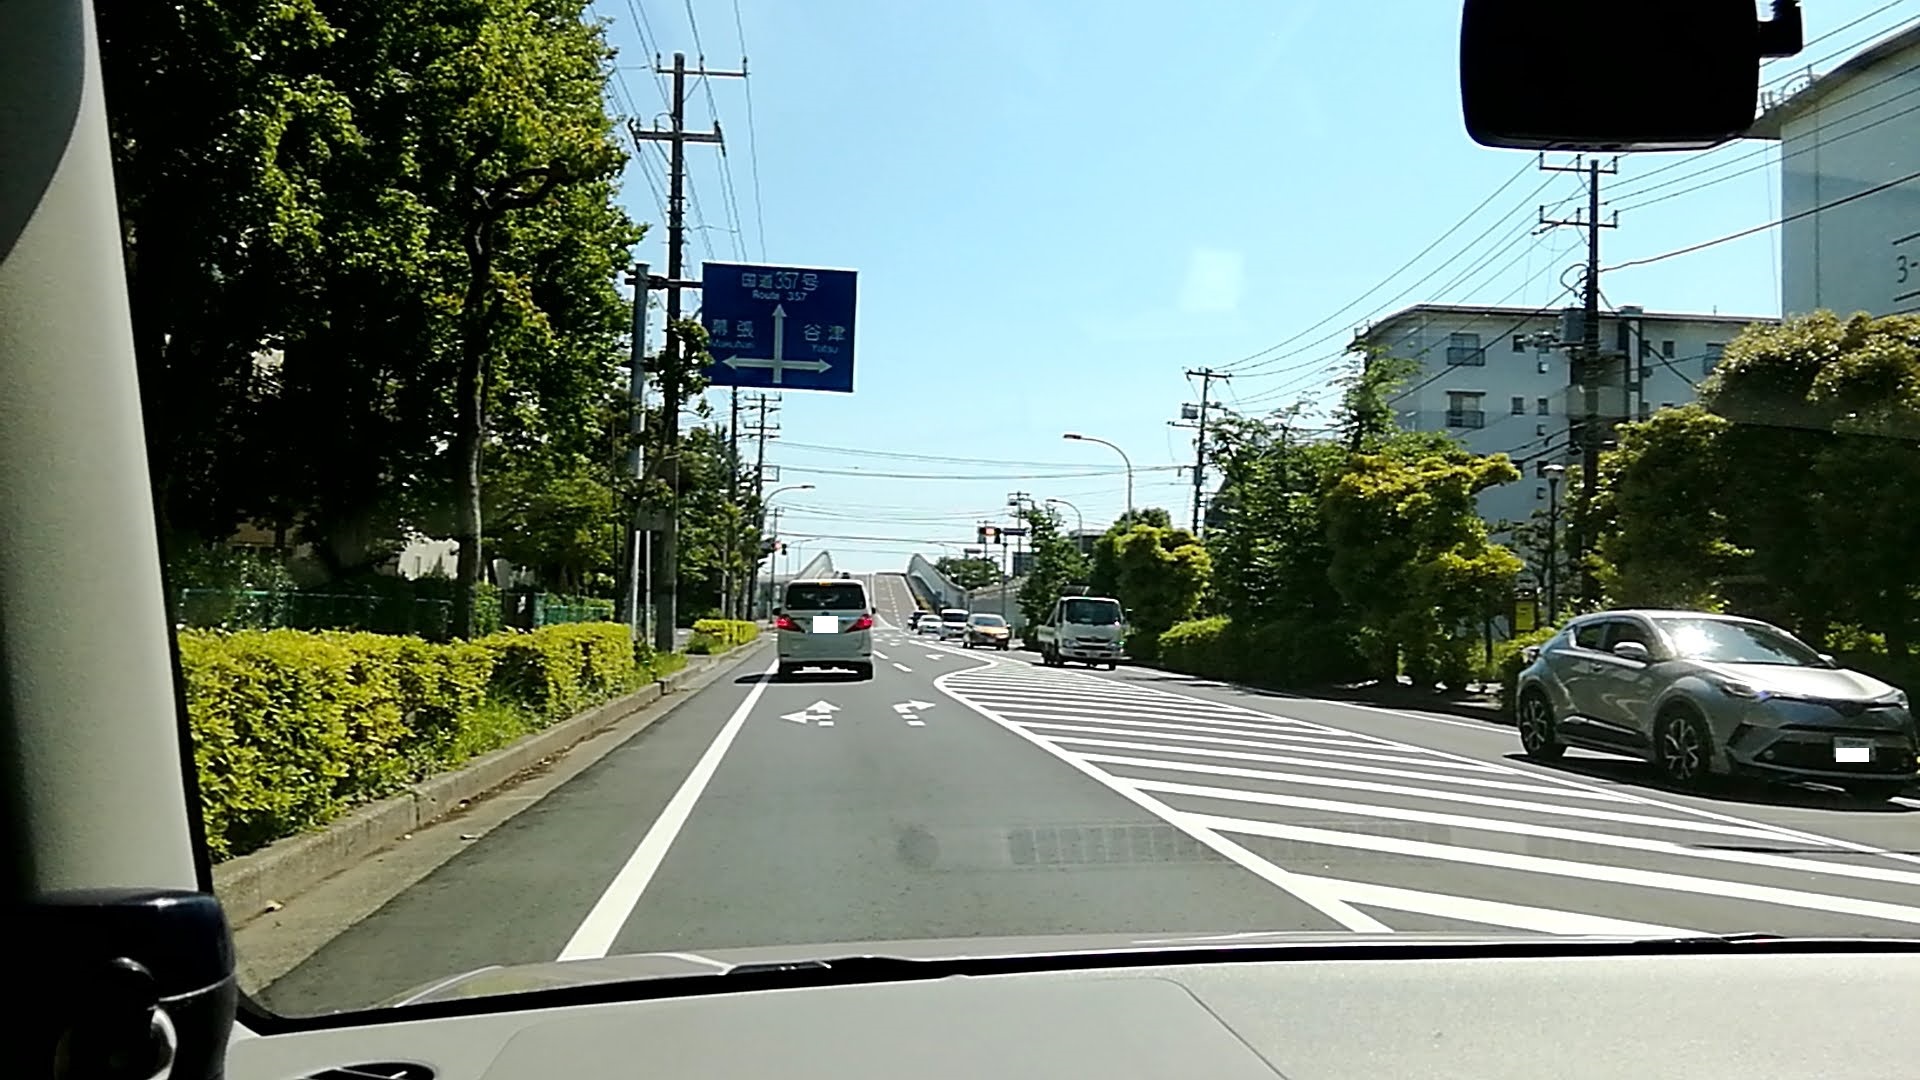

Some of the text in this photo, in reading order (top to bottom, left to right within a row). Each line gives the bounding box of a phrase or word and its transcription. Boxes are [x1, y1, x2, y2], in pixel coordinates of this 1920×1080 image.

[741, 271, 819, 291] 国道357号
[752, 289, 807, 301] Route 357
